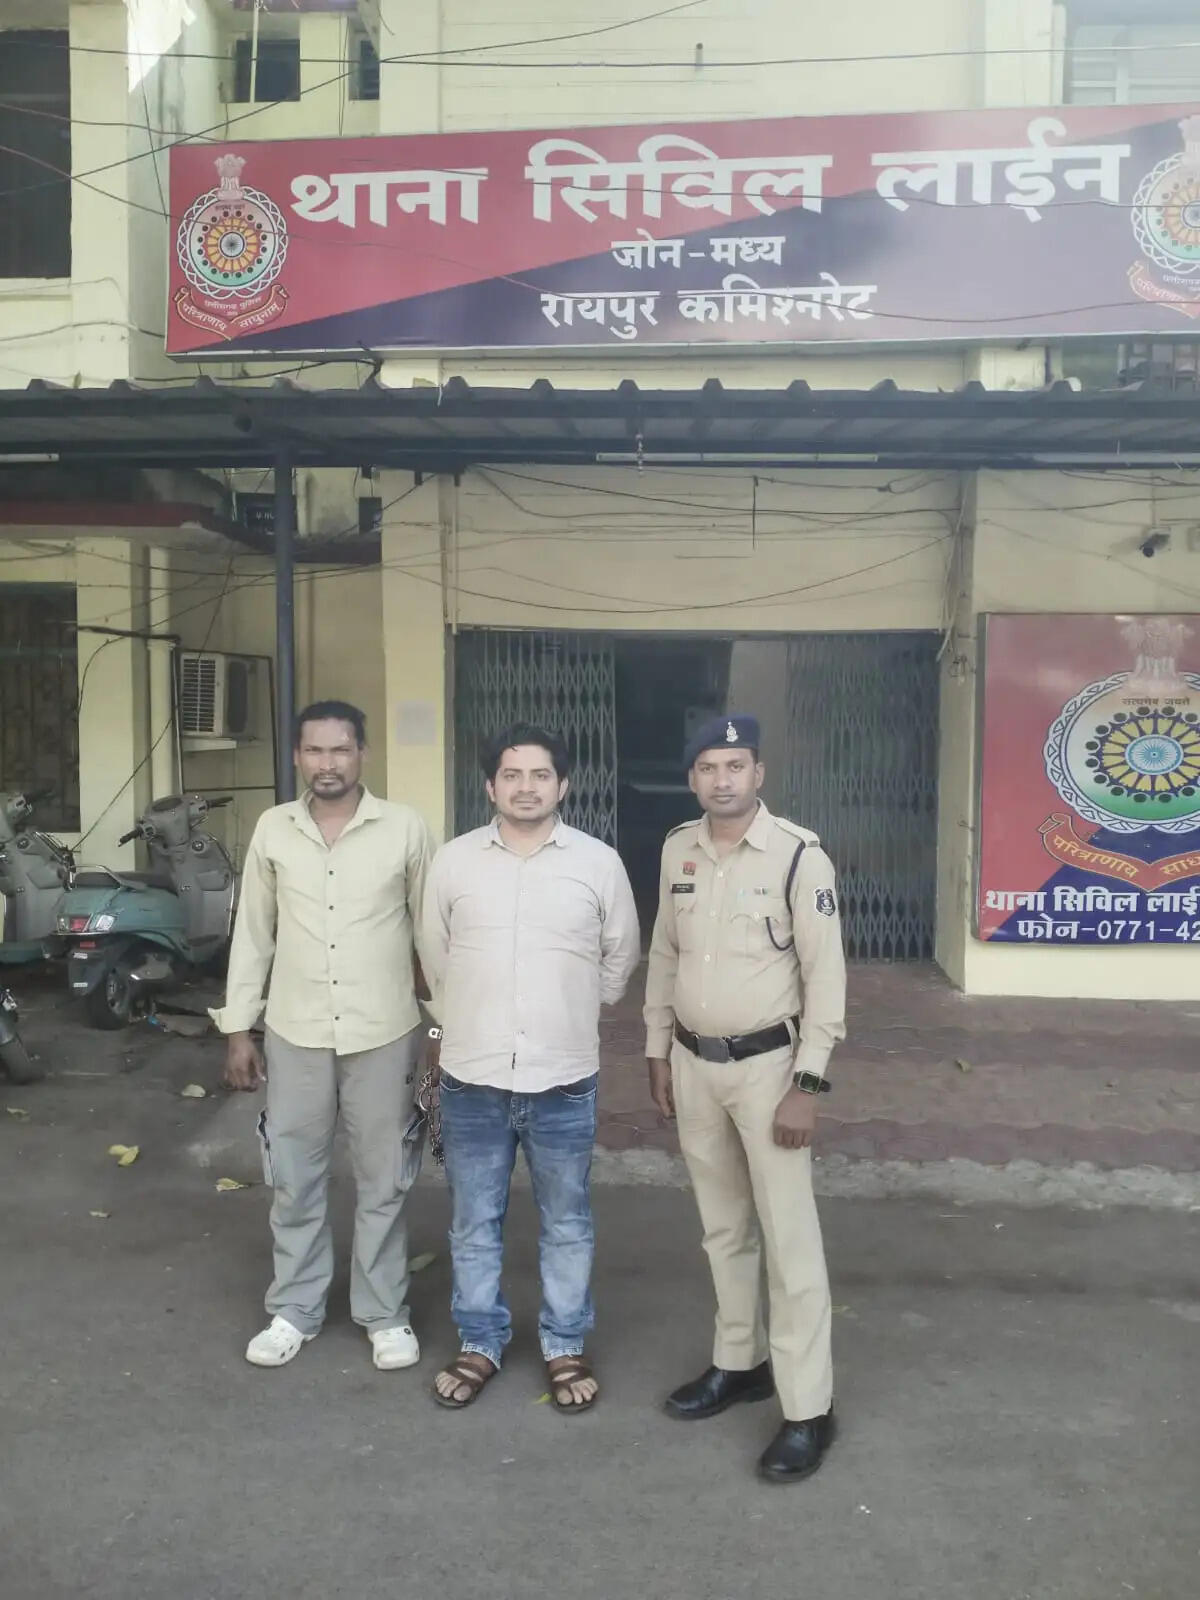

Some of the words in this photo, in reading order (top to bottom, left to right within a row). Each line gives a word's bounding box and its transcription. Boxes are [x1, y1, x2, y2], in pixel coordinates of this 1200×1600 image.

[290, 167, 489, 228] थाना
[524, 133, 834, 223] सिविल
[870, 116, 1131, 222] लाईन
[539, 290, 662, 340] रायपुर
[677, 271, 878, 326] कमिश्नरेट
[985, 889, 1048, 913] थाना
[1053, 885, 1140, 913] सिविल
